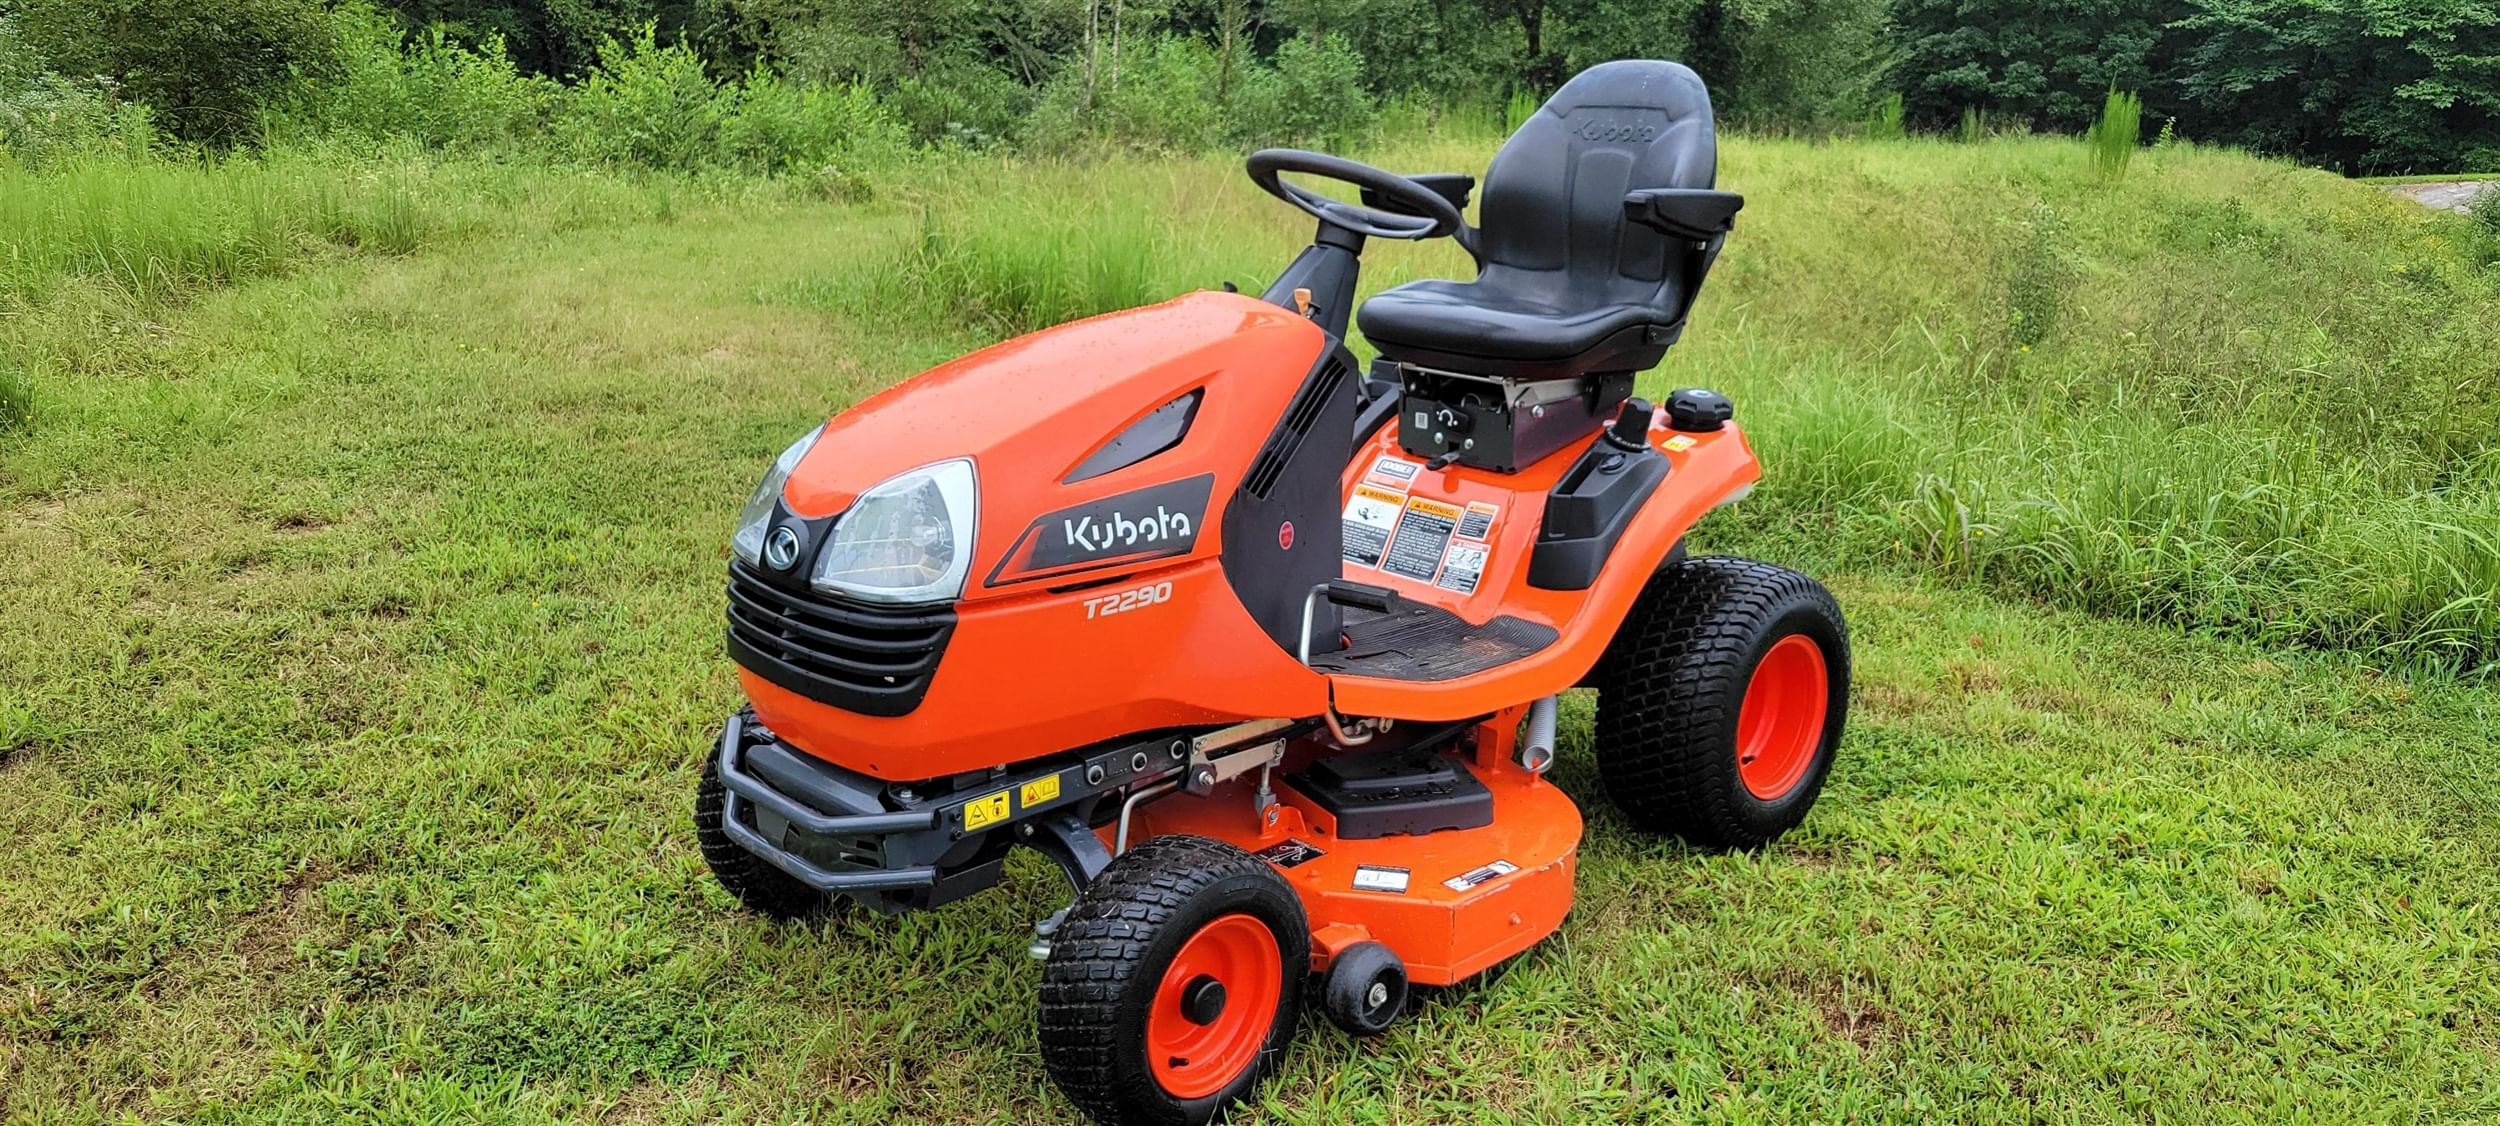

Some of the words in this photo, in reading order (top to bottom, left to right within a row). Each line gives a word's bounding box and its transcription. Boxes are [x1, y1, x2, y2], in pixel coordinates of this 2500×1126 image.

[1064, 505, 1192, 551] Kubota
[1423, 502, 1455, 516] WARNING
[1083, 581, 1173, 620] T2290
